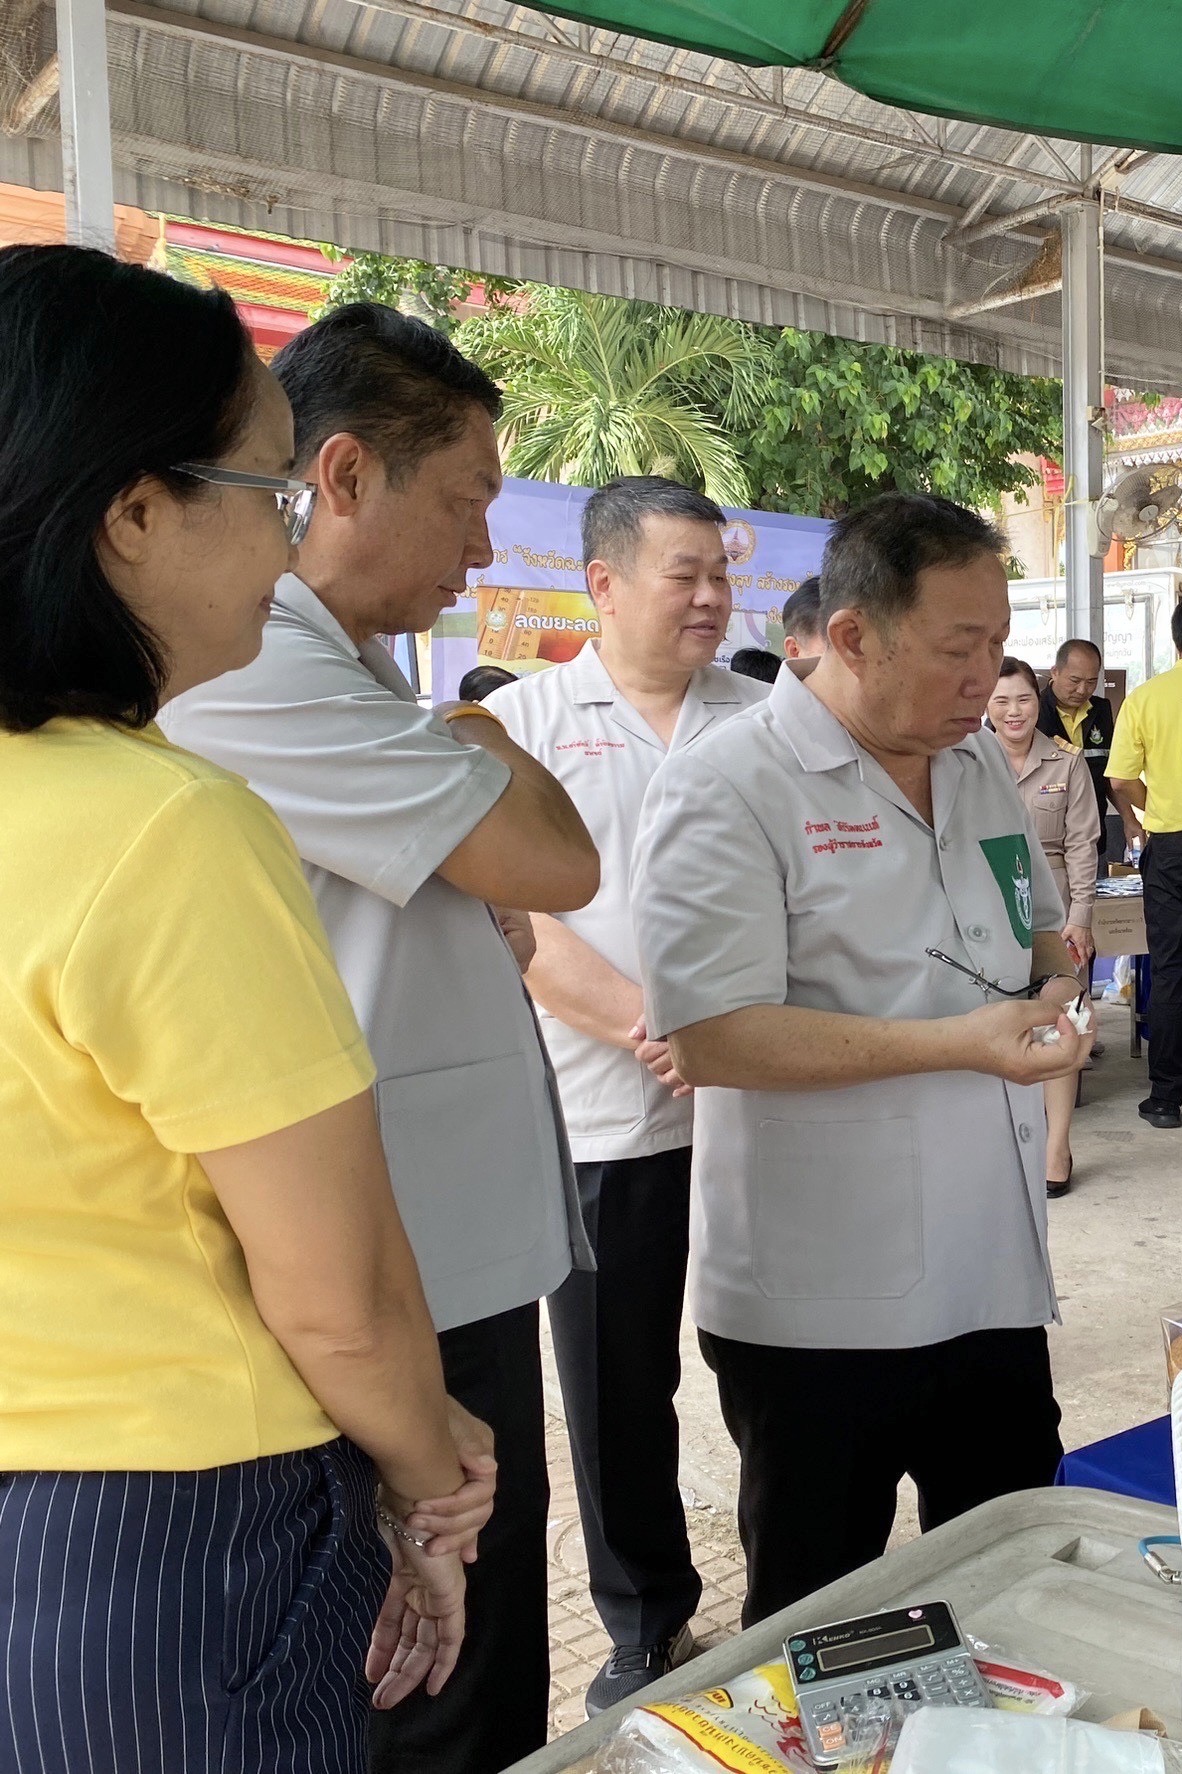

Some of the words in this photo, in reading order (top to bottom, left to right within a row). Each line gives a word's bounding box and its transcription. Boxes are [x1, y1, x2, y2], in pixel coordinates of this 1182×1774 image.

[493, 550, 508, 564] าร
[515, 614, 600, 632] ลดขยะลด
[814, 1701, 832, 1711] OFF
[822, 1724, 838, 1733] CE
[825, 1734, 844, 1746] ON
